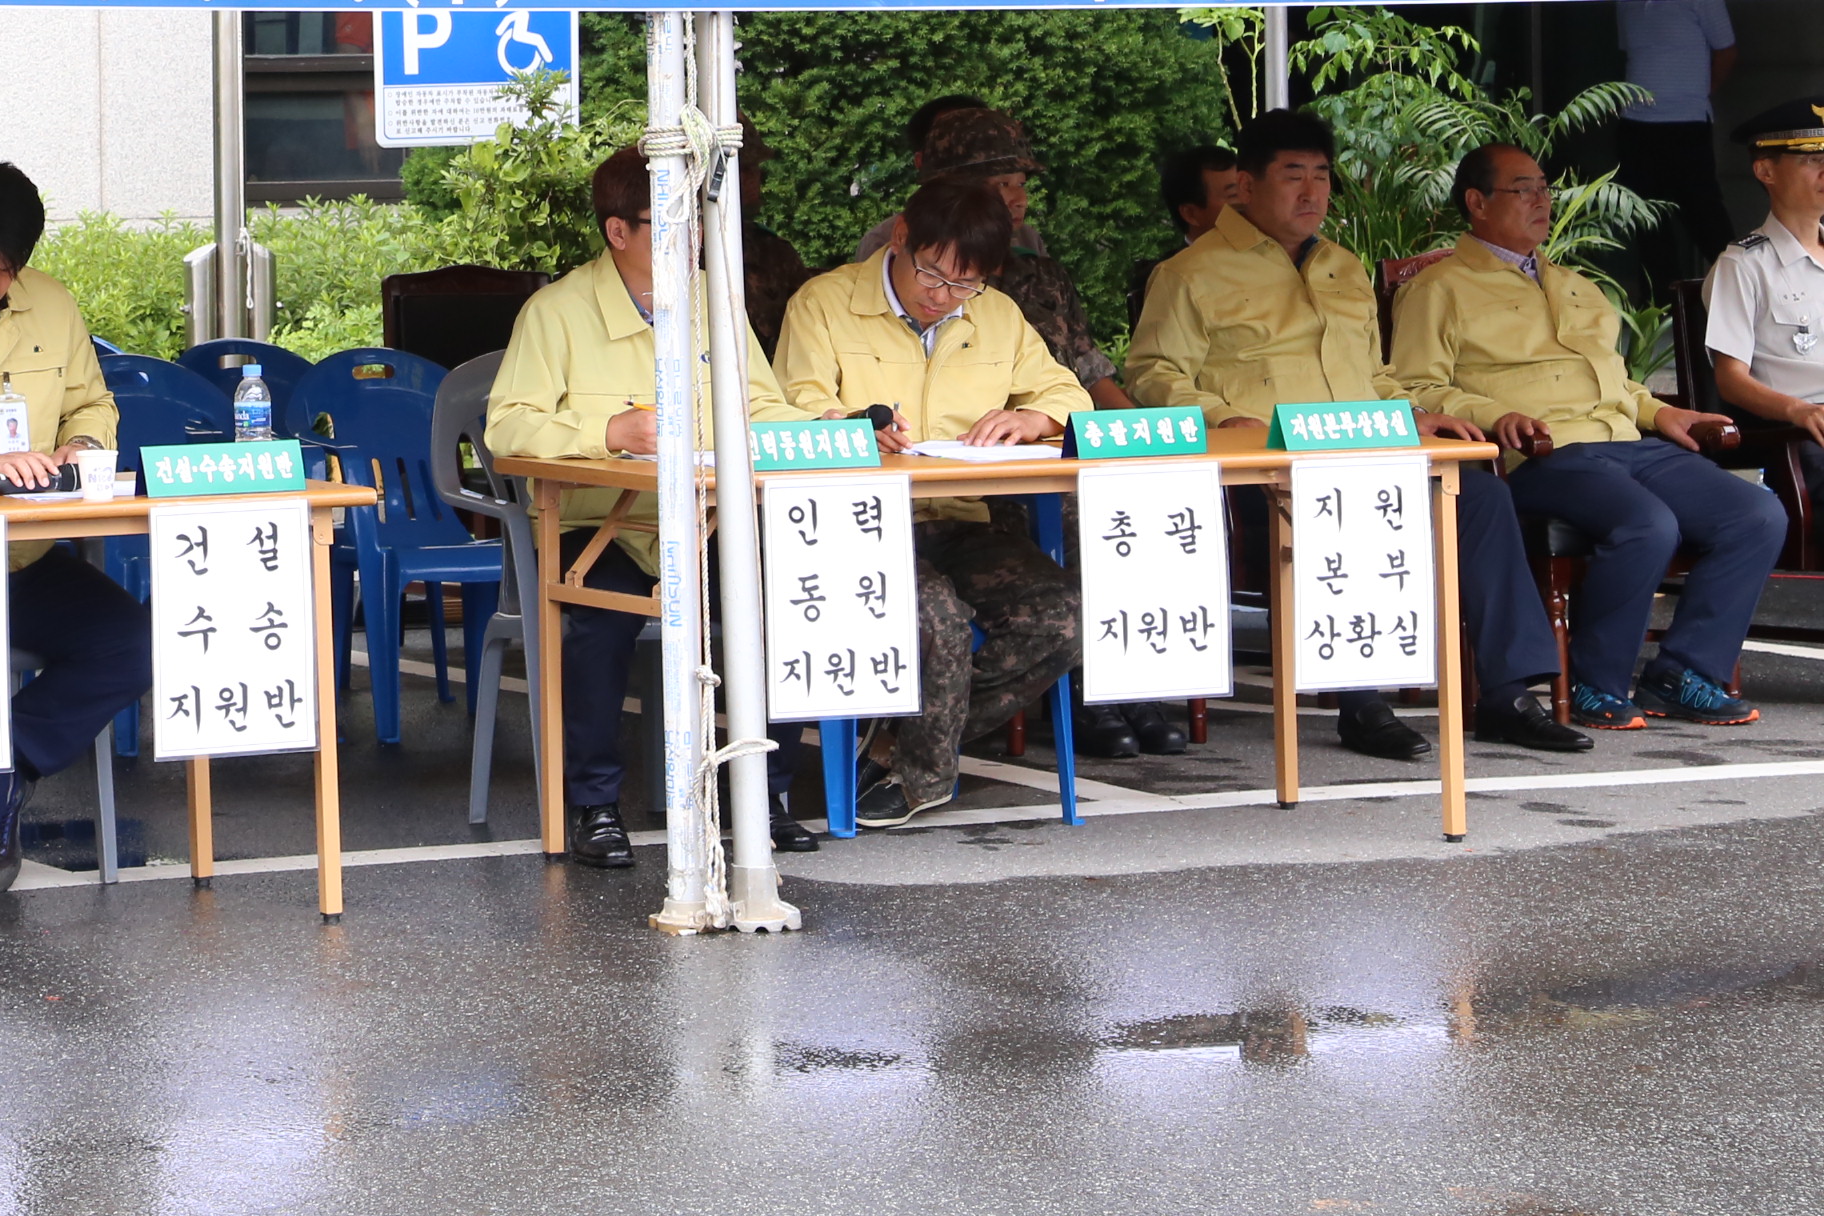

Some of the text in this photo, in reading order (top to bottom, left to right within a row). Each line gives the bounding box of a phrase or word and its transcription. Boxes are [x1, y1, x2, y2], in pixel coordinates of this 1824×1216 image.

[402, 10, 453, 75] P
[1085, 417, 1197, 447] 총괄지원반
[1291, 410, 1408, 440] 지원본부상황실
[1097, 605, 1216, 655] 지원반
[1305, 610, 1419, 662] 상황실
[780, 646, 908, 698] 지원반
[166, 679, 304, 734] 지원반
